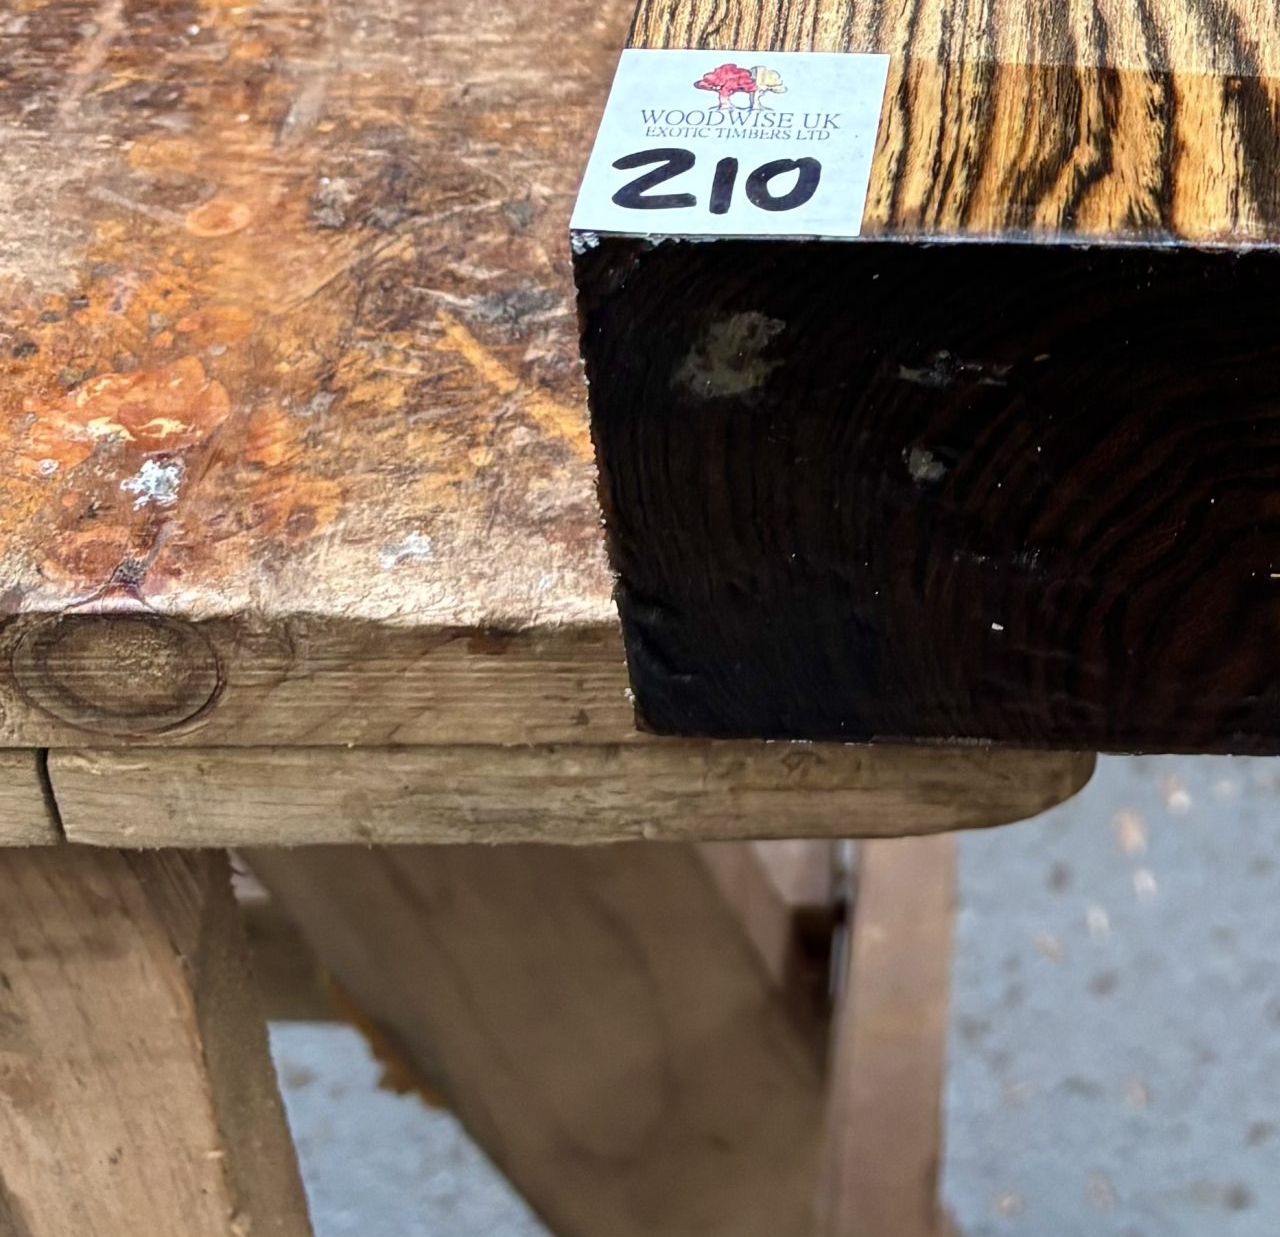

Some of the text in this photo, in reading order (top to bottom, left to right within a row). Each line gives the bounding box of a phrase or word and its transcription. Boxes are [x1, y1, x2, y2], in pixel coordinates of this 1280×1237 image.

[641, 109, 842, 129] WOODWISE UK
[645, 126, 830, 141] EXOTIC TIMBERS LTD
[611, 147, 822, 215] 210
